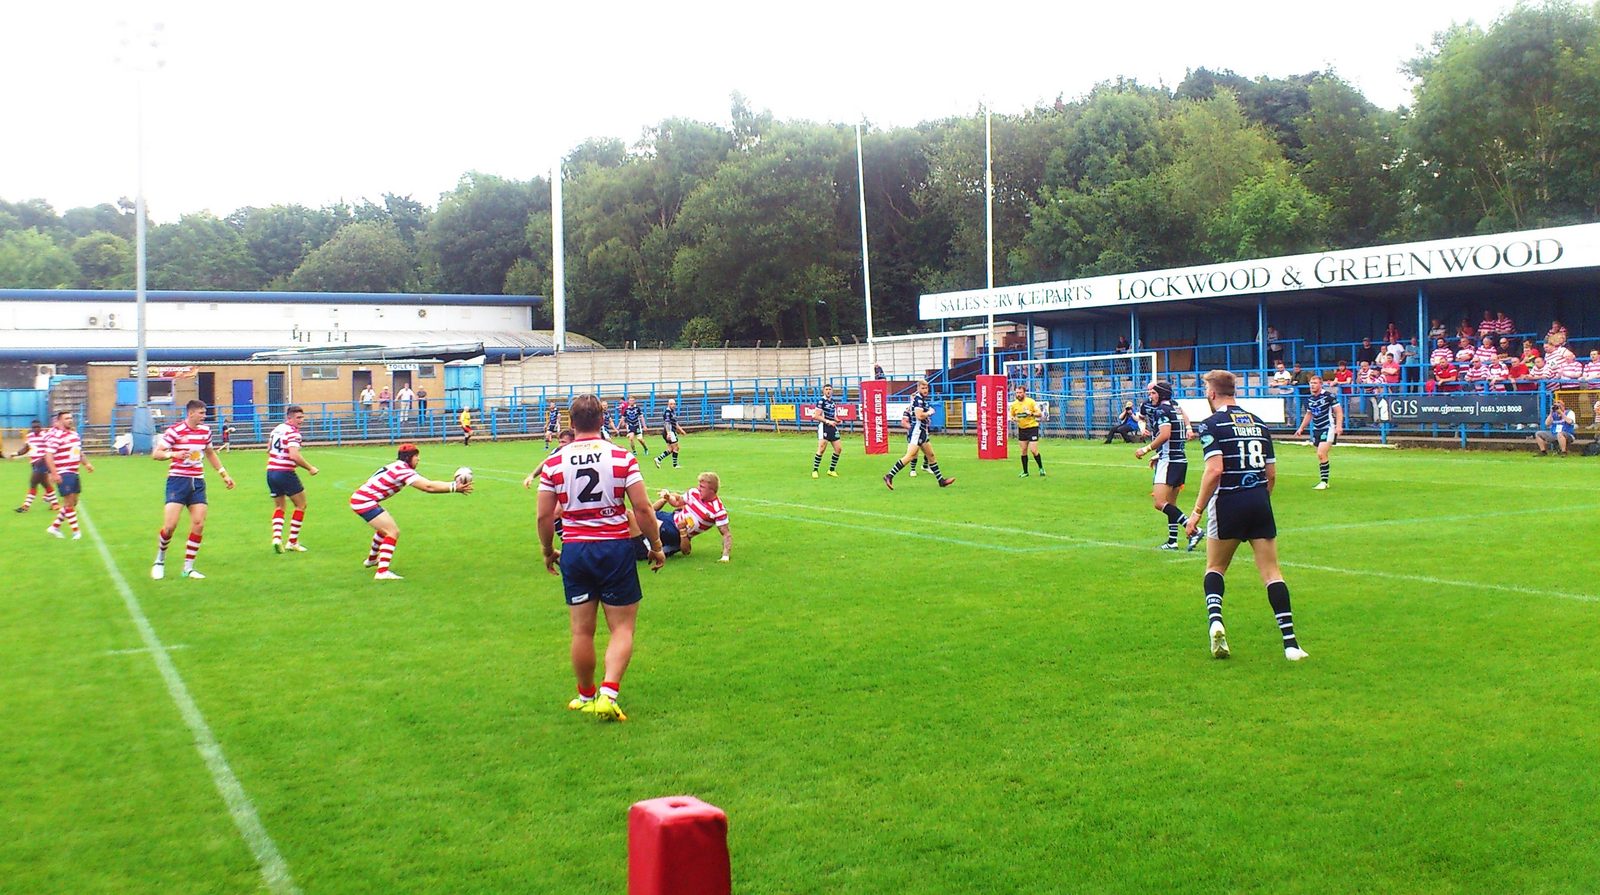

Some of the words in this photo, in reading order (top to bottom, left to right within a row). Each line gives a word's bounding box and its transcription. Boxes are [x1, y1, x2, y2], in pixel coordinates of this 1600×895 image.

[1118, 266, 1271, 300] LOCKWOOD
[1281, 265, 1304, 287] &
[1314, 238, 1564, 284] GREENWOOD
[940, 296, 981, 312] SALES
[1045, 285, 1093, 304] PARTS
[874, 393, 882, 414] CIDER
[1391, 400, 1418, 415] GJS
[1421, 404, 1475, 414] www.gjswm.org
[1480, 405, 1495, 413] 0161
[1496, 405, 1507, 413] 303
[1507, 405, 1522, 413] 8008
[875, 415, 883, 443] PROPER
[1232, 426, 1263, 436] TURNER
[570, 453, 602, 465] CLAY
[1237, 440, 1265, 469] 18
[575, 467, 603, 503] 2
